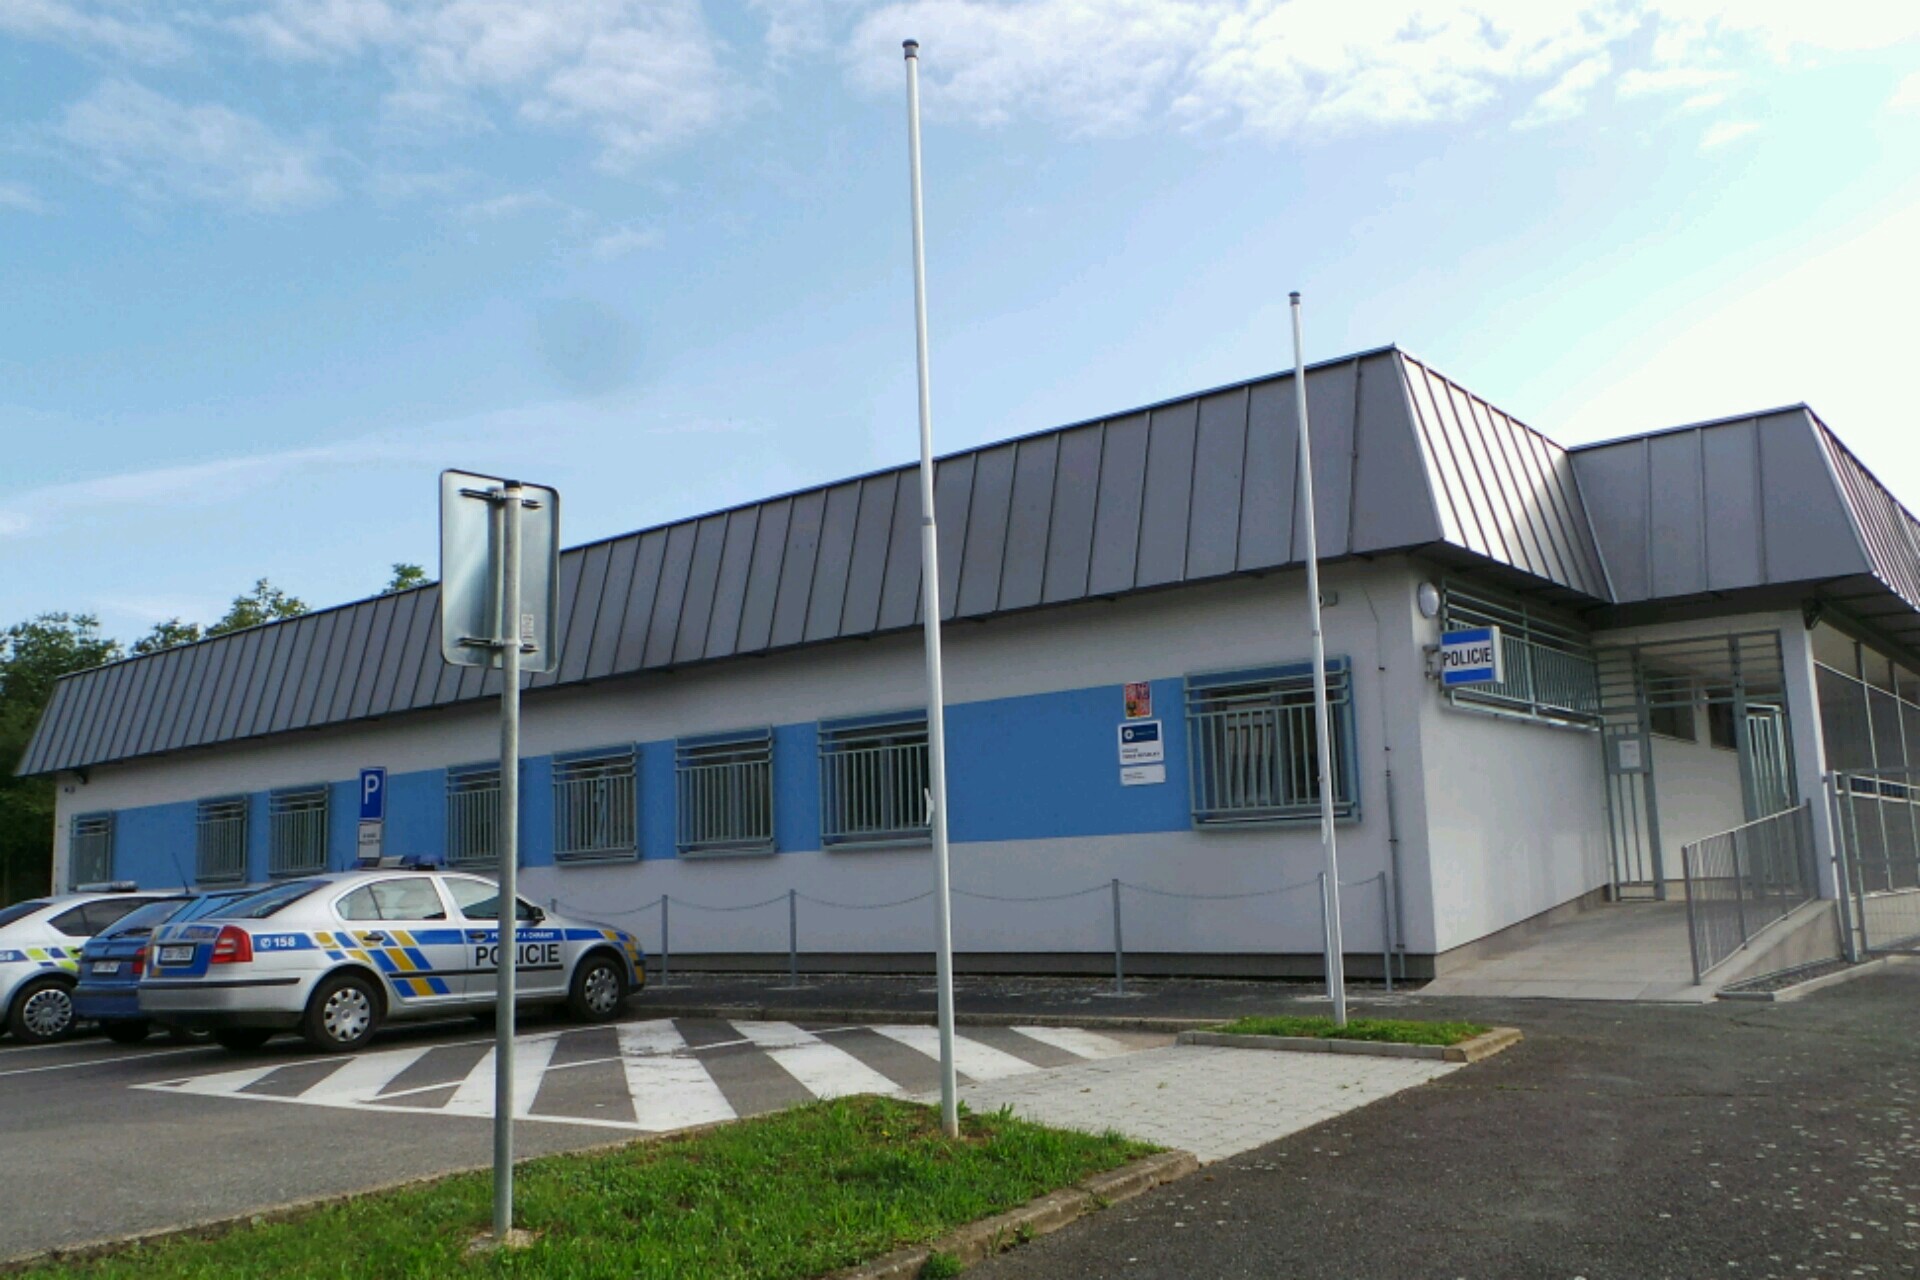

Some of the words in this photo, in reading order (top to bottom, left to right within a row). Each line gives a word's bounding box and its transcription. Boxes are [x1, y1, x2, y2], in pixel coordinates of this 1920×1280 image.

[1442, 647, 1492, 667] POLICIE
[364, 774, 380, 805] P
[273, 936, 296, 948] 158
[475, 943, 560, 967] POICIE
